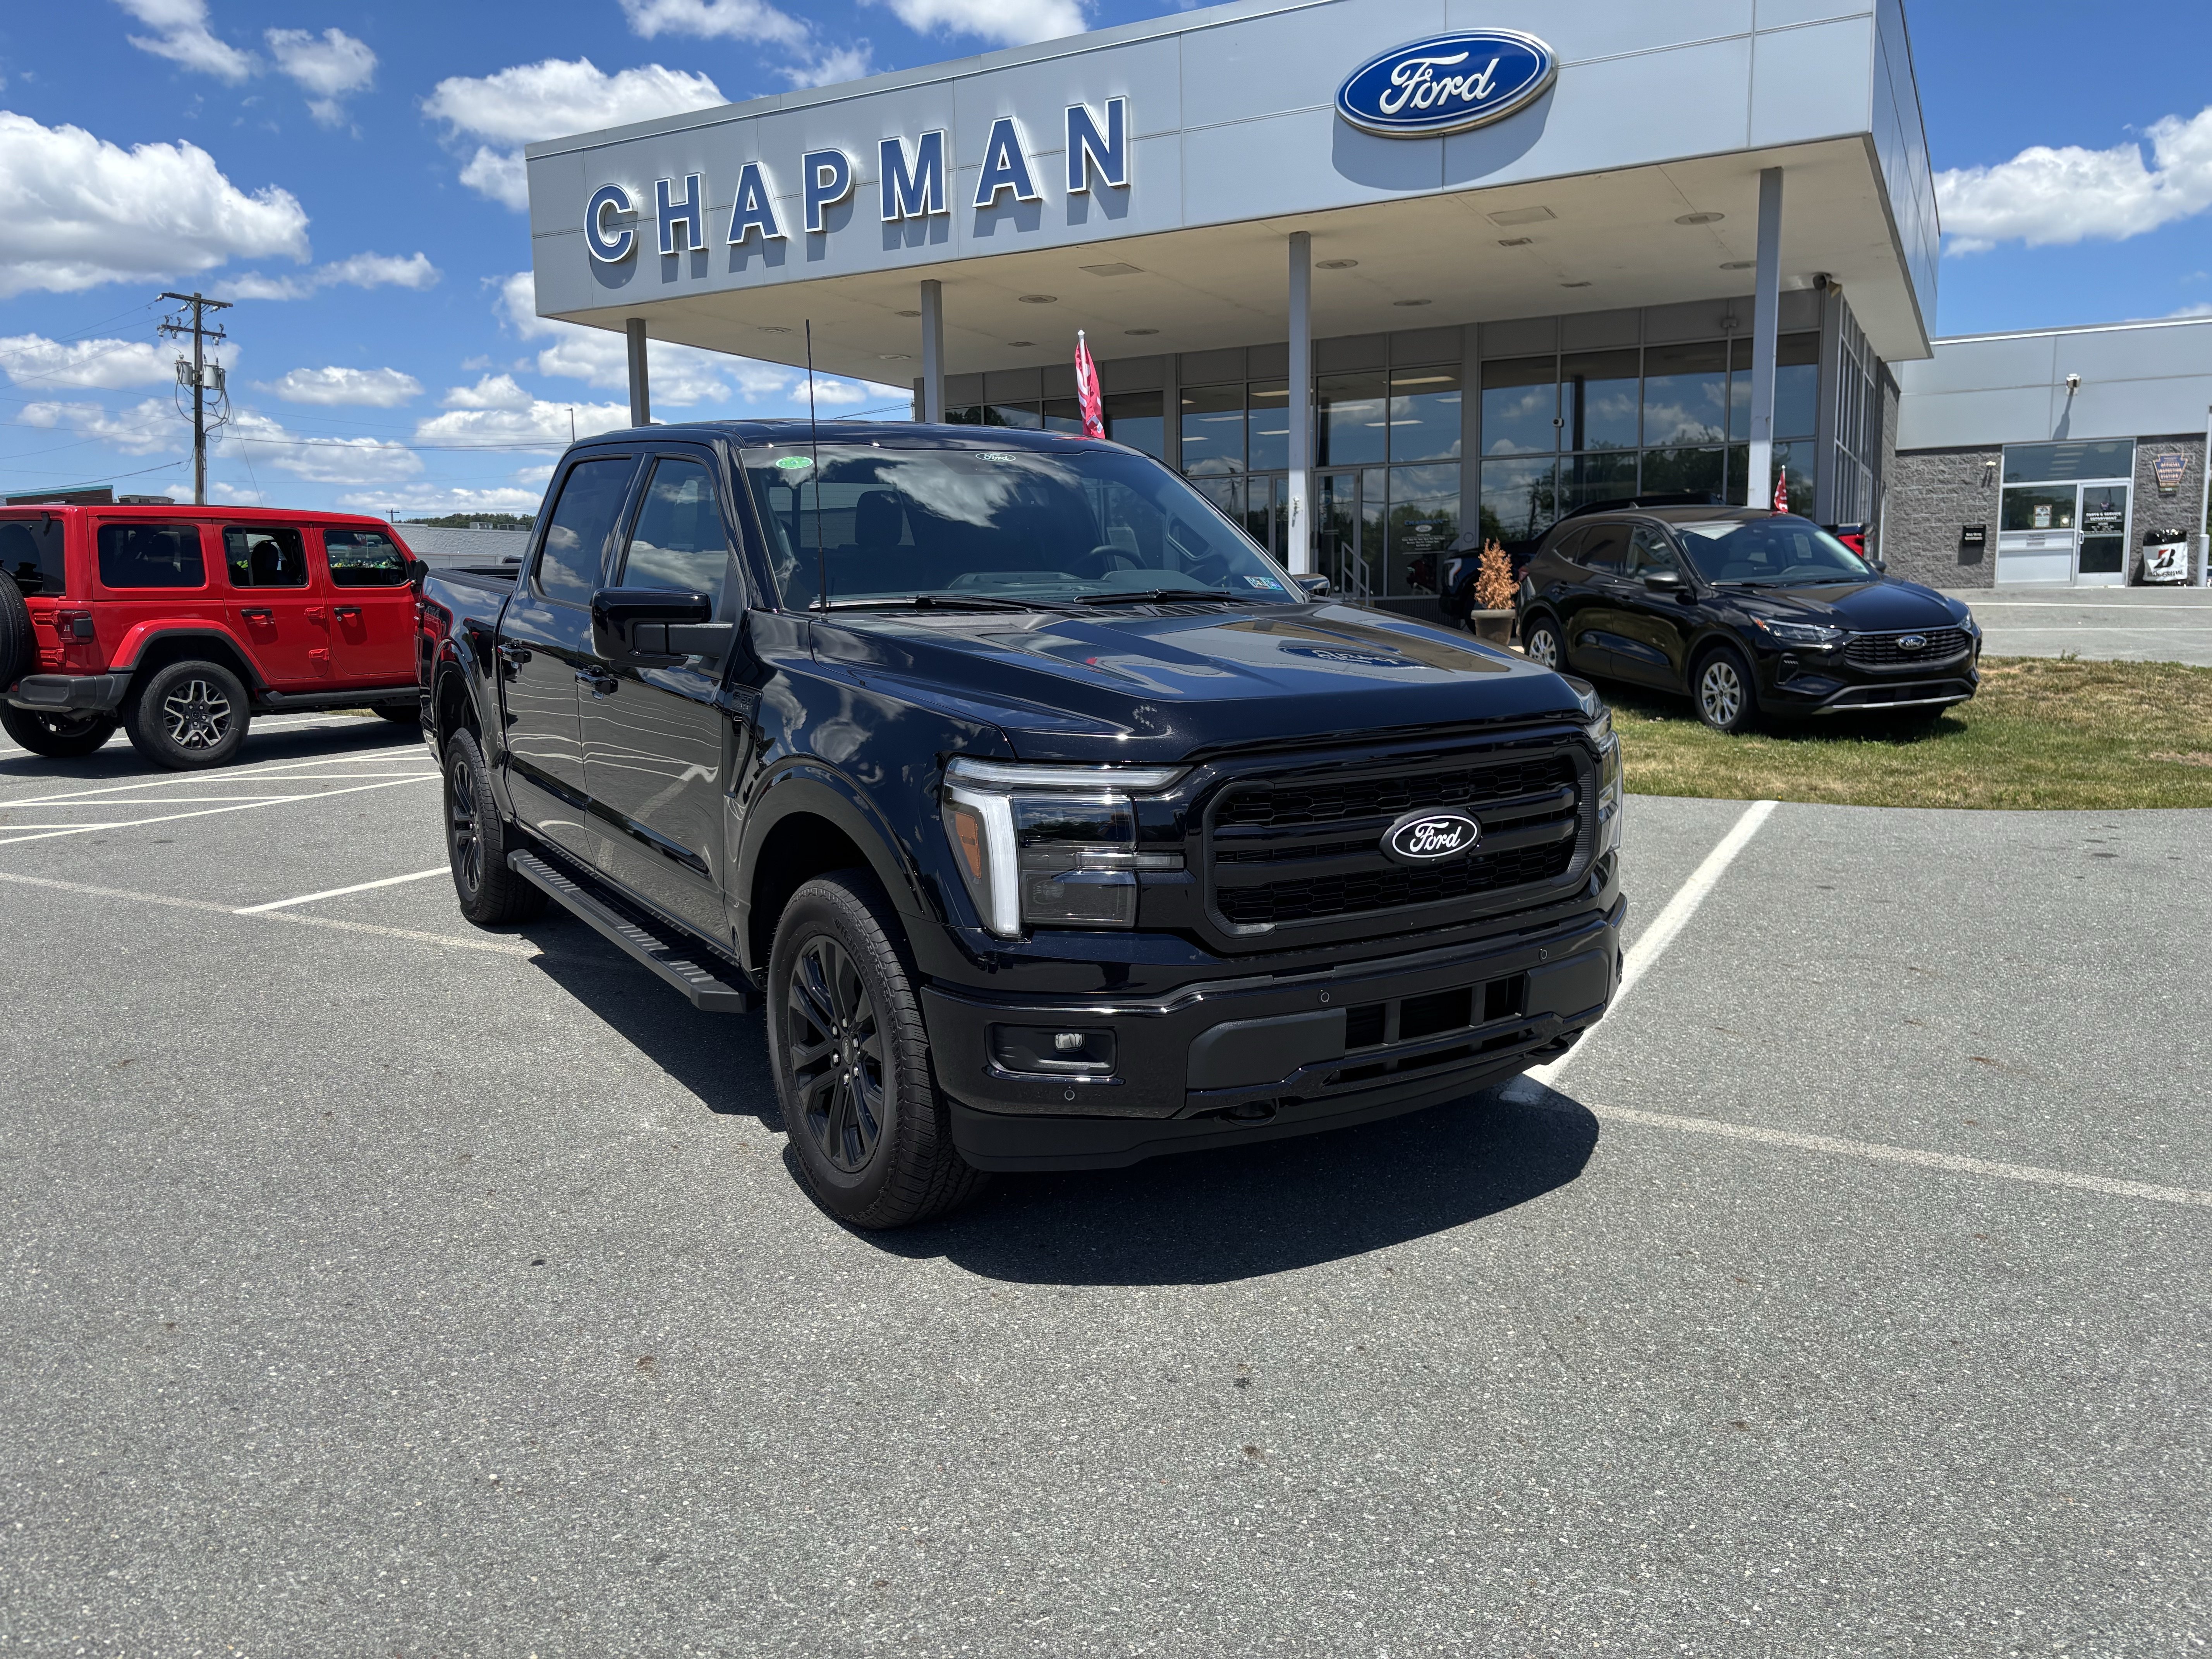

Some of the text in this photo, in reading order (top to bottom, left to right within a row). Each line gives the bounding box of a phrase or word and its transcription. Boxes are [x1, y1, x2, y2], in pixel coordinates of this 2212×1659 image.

[1379, 52, 1499, 114] Ford
[585, 96, 1130, 263] CHAPMAN
[1410, 822, 1462, 852] Ford
